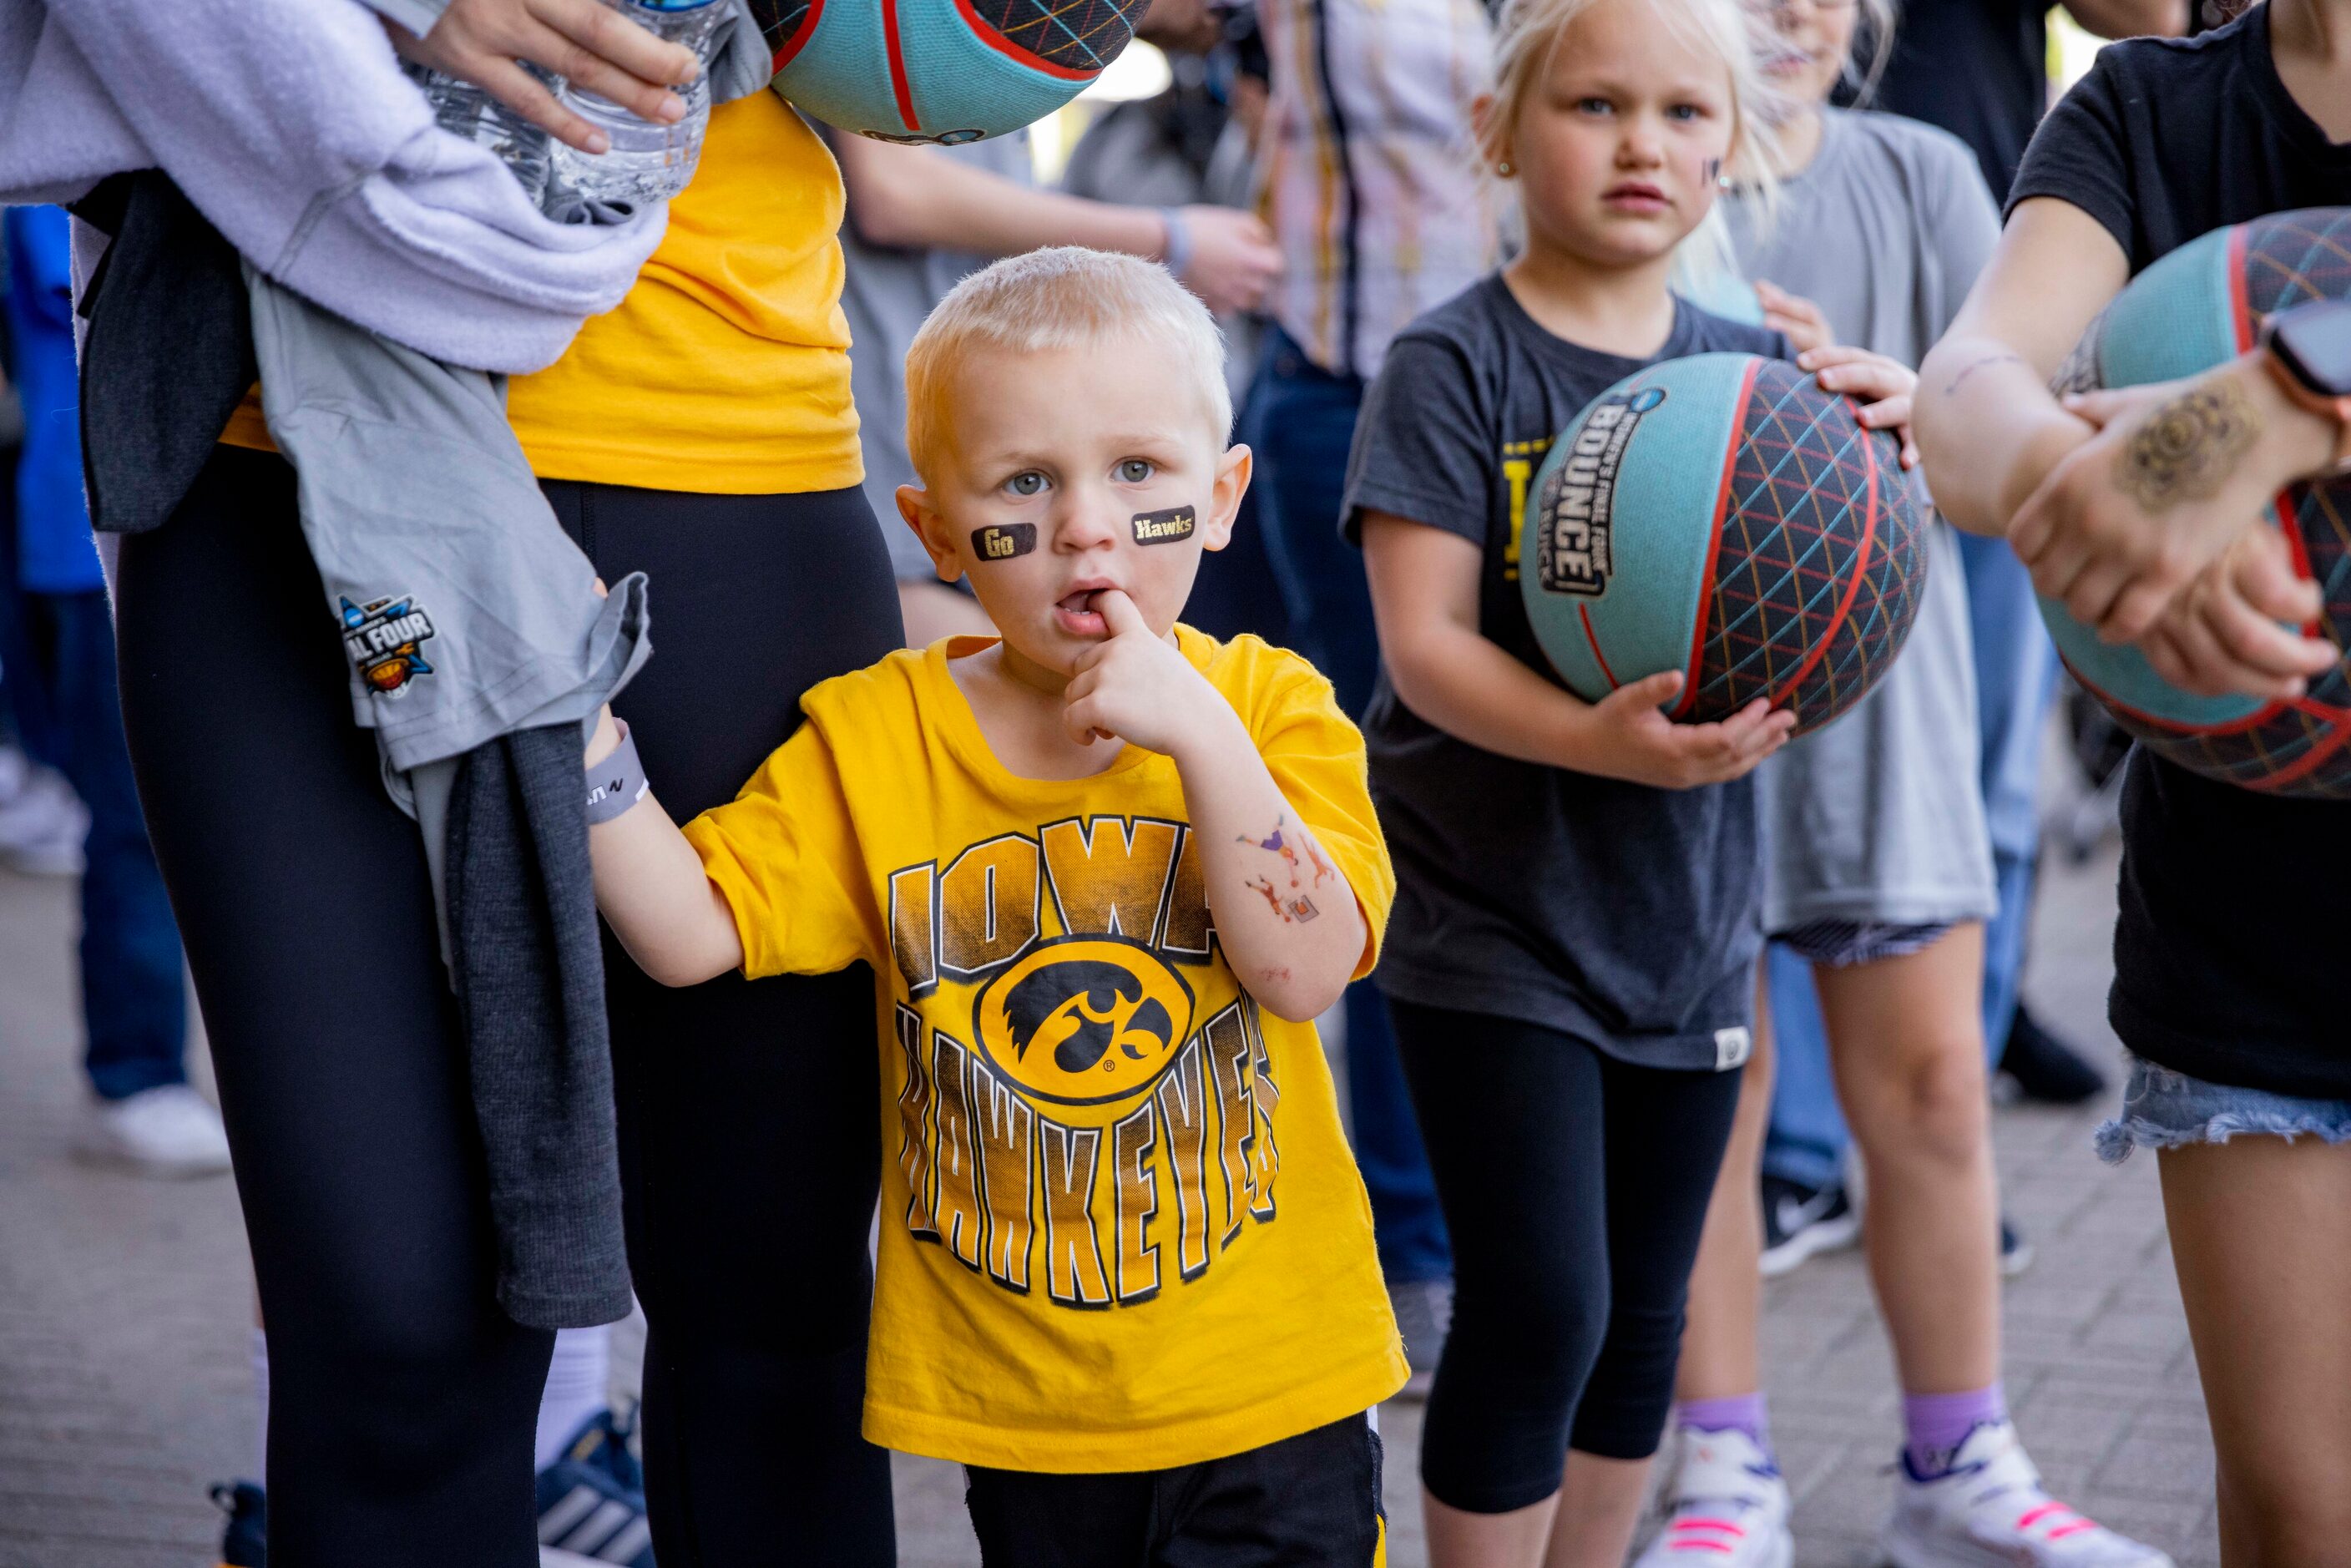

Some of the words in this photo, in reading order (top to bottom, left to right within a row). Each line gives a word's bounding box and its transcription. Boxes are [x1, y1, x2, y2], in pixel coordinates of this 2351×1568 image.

[1555, 404, 1628, 580] BOUNCE
[984, 529, 1014, 557] Go
[1135, 514, 1193, 539] Hawks
[367, 612, 432, 654] FOUR
[896, 992, 1281, 1309] HAWKEYES
